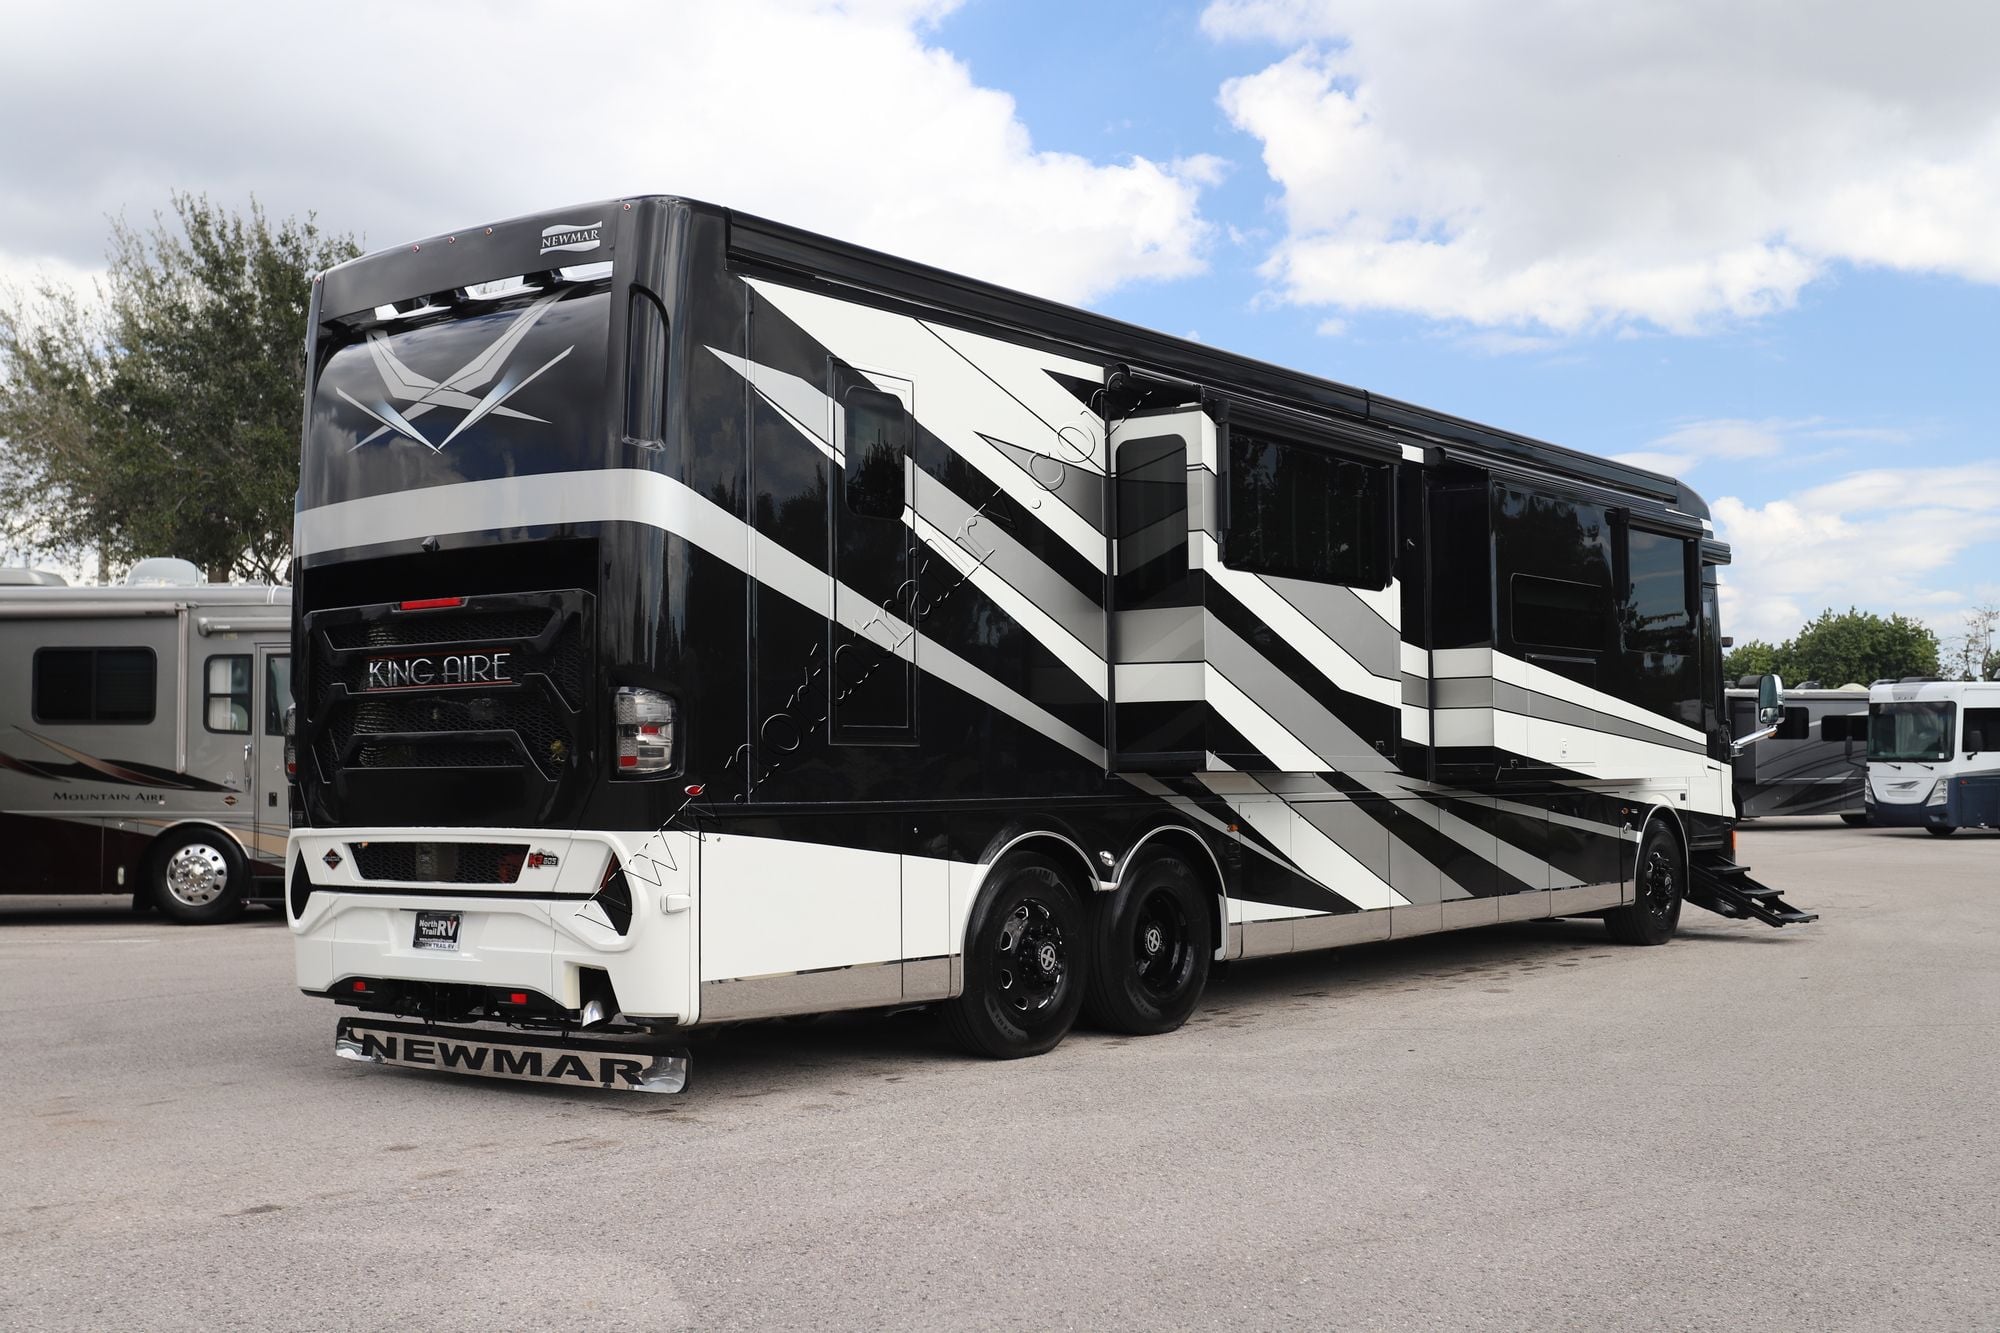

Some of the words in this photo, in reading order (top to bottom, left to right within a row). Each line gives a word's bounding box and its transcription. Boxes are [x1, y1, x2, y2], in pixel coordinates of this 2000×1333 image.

[541, 229, 600, 248] NEWMAR
[369, 658, 435, 687] KING
[441, 653, 511, 683] AIRE
[419, 919, 438, 928] North
[422, 927, 437, 936] Trail
[437, 920, 457, 937] RV
[362, 1033, 645, 1086] NEWMAR
